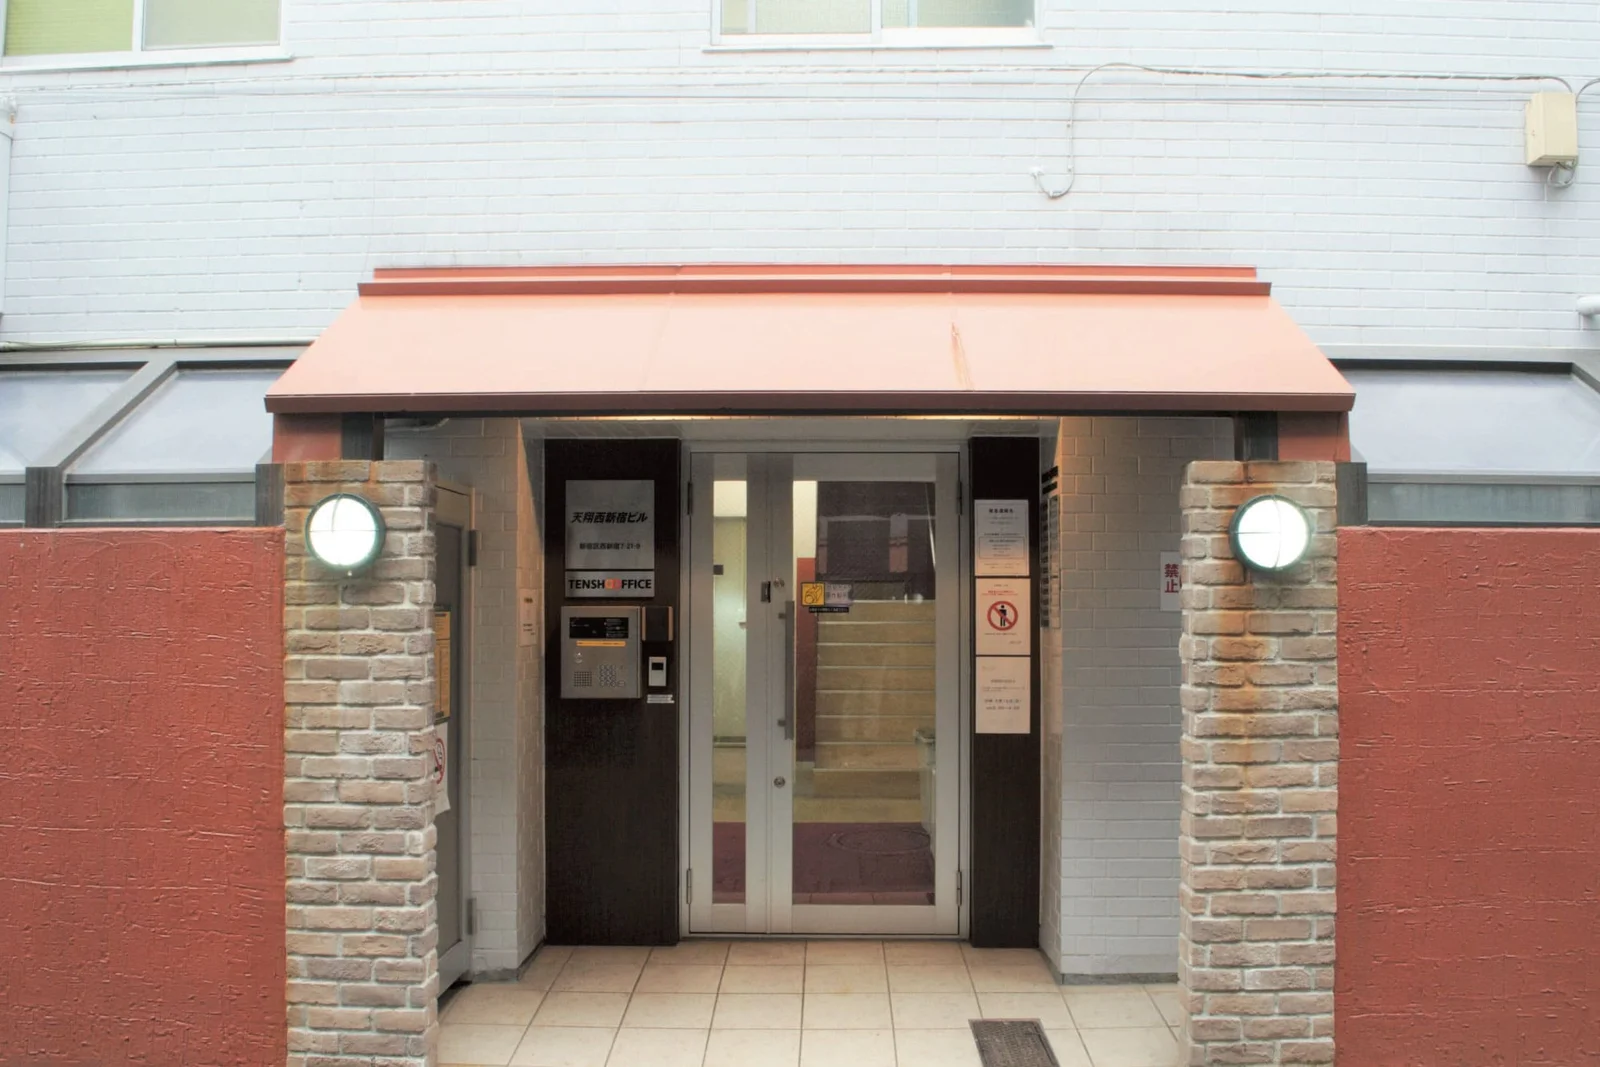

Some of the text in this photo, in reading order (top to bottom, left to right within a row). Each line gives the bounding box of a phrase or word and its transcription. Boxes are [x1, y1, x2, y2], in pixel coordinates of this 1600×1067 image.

[571, 511, 648, 524] 天翔西新宿ビル
[1164, 563, 1179, 593] 禁止
